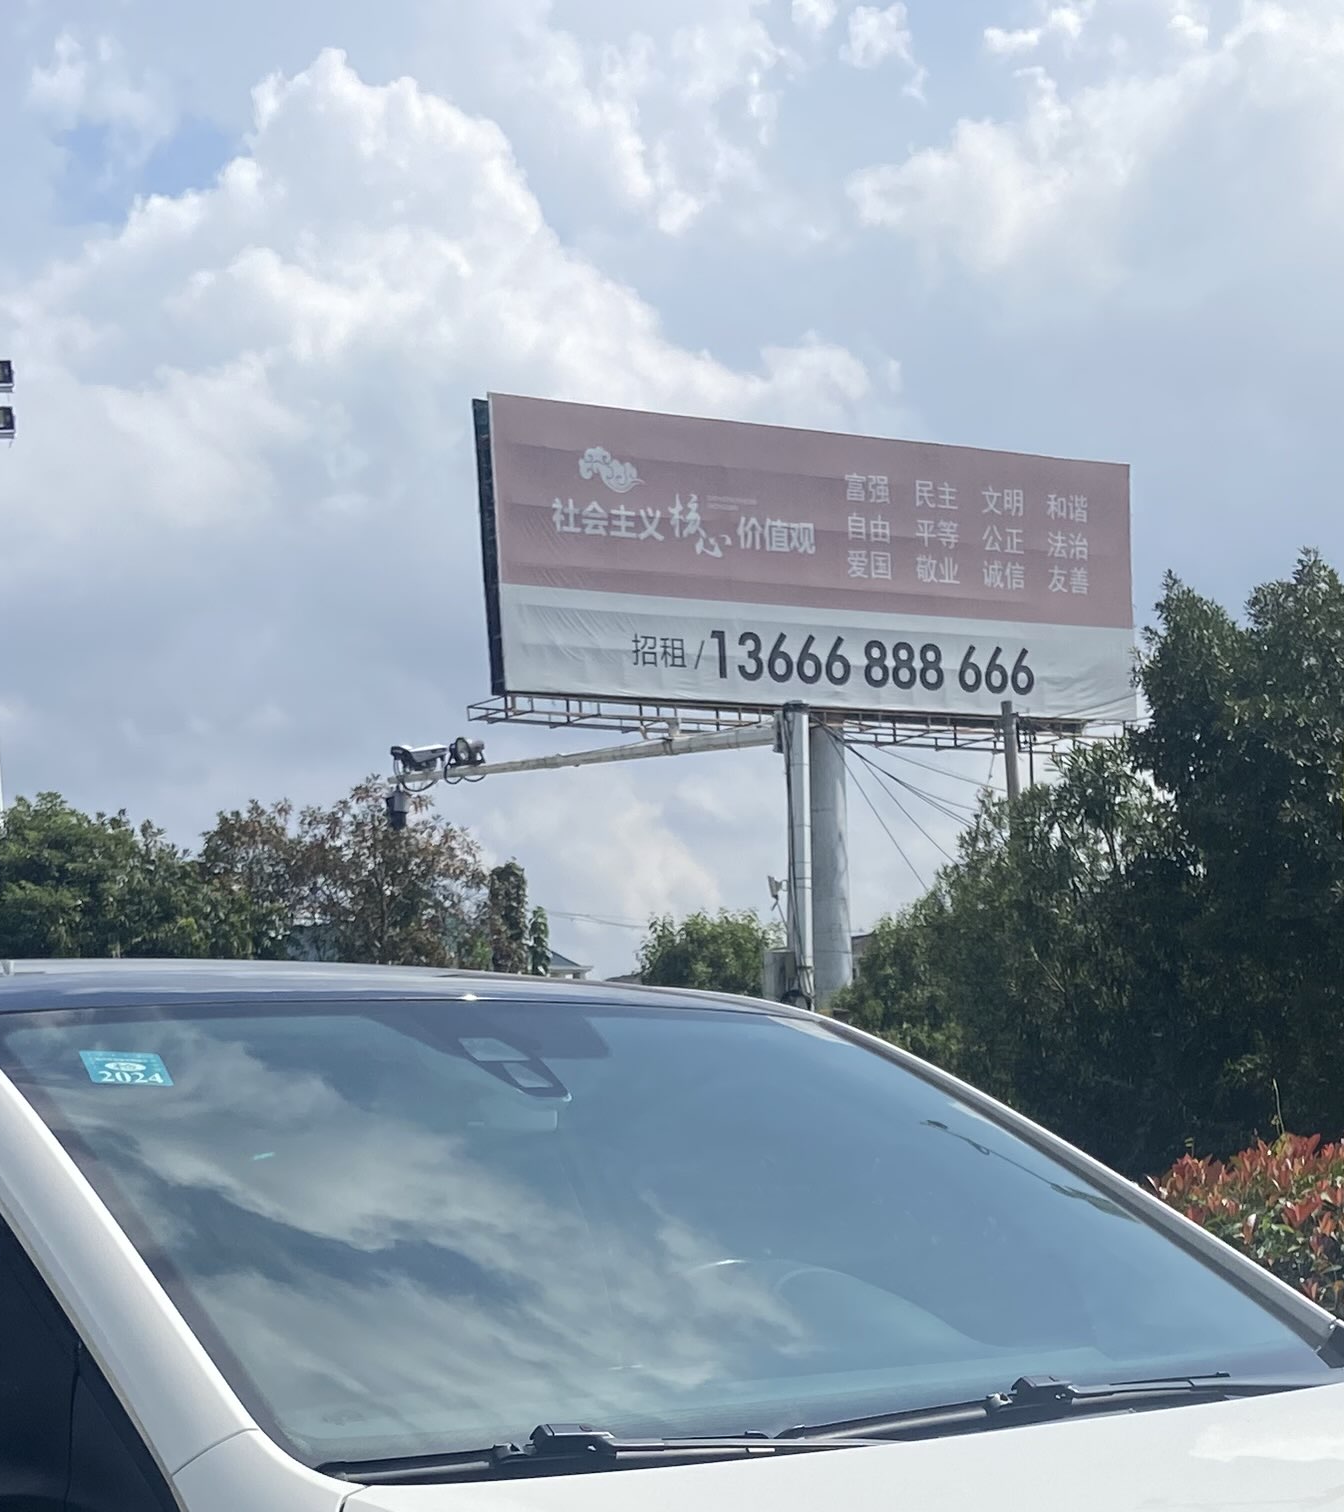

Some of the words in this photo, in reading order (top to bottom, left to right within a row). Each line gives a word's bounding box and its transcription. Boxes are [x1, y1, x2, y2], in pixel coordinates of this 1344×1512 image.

[845, 473, 890, 504] 富强
[915, 480, 958, 510] 民主
[981, 485, 1024, 517] 文明
[1047, 494, 1088, 523] 和谐
[847, 513, 890, 544] 自由
[916, 519, 959, 549] 平等
[982, 524, 1024, 555] 公正
[1047, 531, 1088, 561] 法治
[847, 550, 892, 580] 爱国
[916, 554, 960, 584] 敬业
[983, 560, 1025, 590] 诚信
[1048, 565, 1089, 595] 友善
[98, 1071, 163, 1084] 2024
